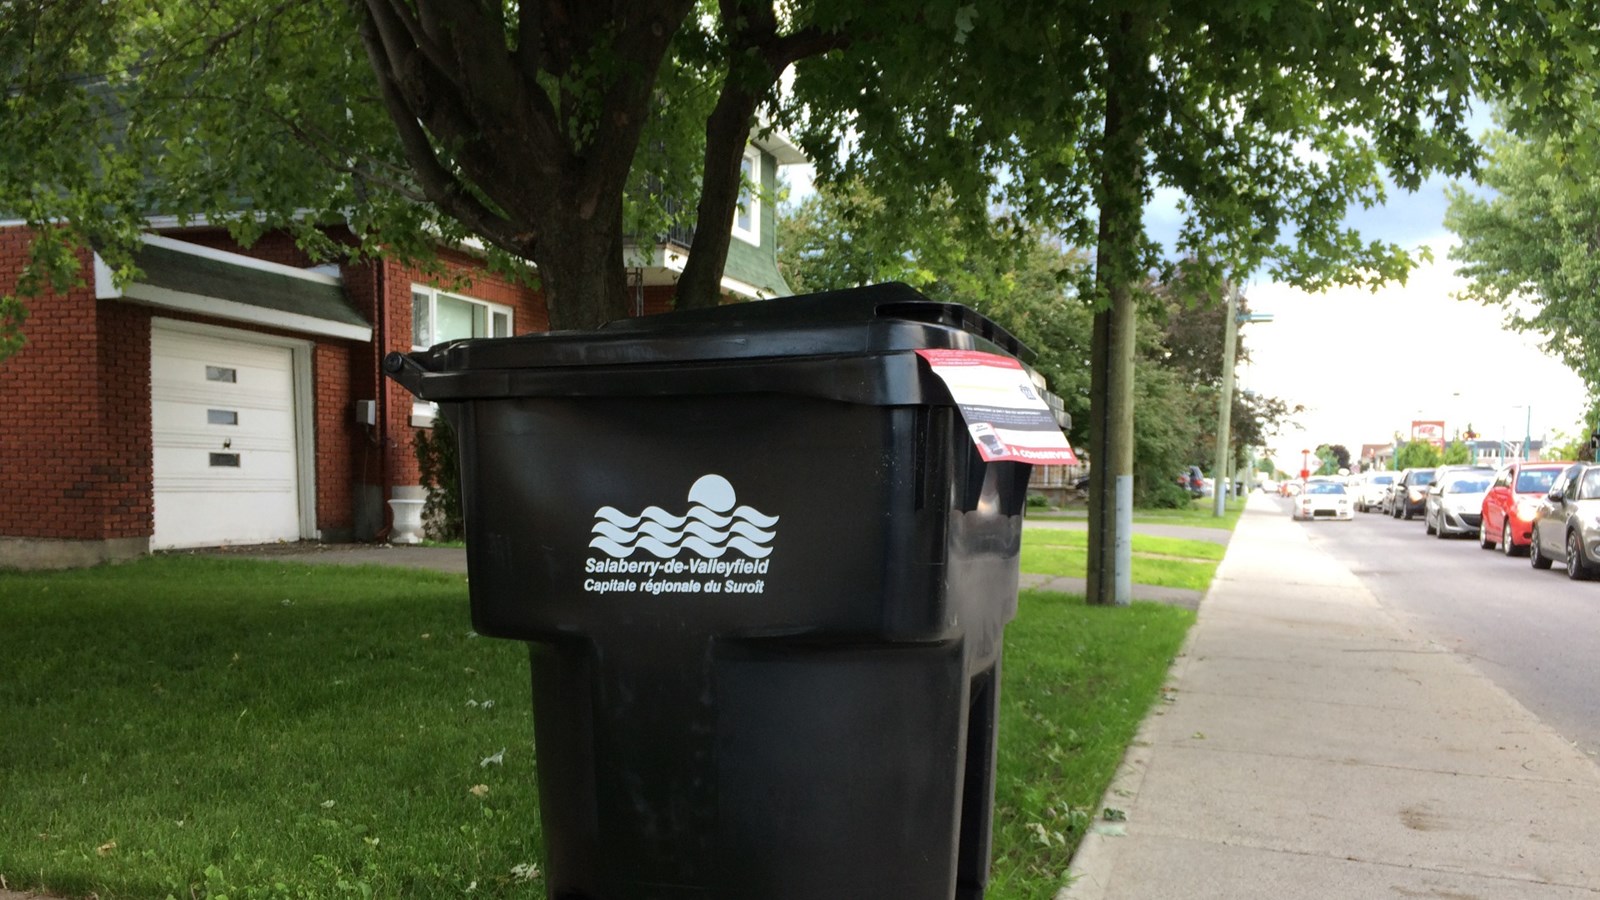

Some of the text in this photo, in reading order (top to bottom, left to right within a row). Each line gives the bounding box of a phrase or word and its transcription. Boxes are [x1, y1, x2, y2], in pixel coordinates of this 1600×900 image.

[585, 558, 770, 577] Salaberry-de-Valleyfield
[584, 579, 765, 595] Capitale régionale du Suroît
